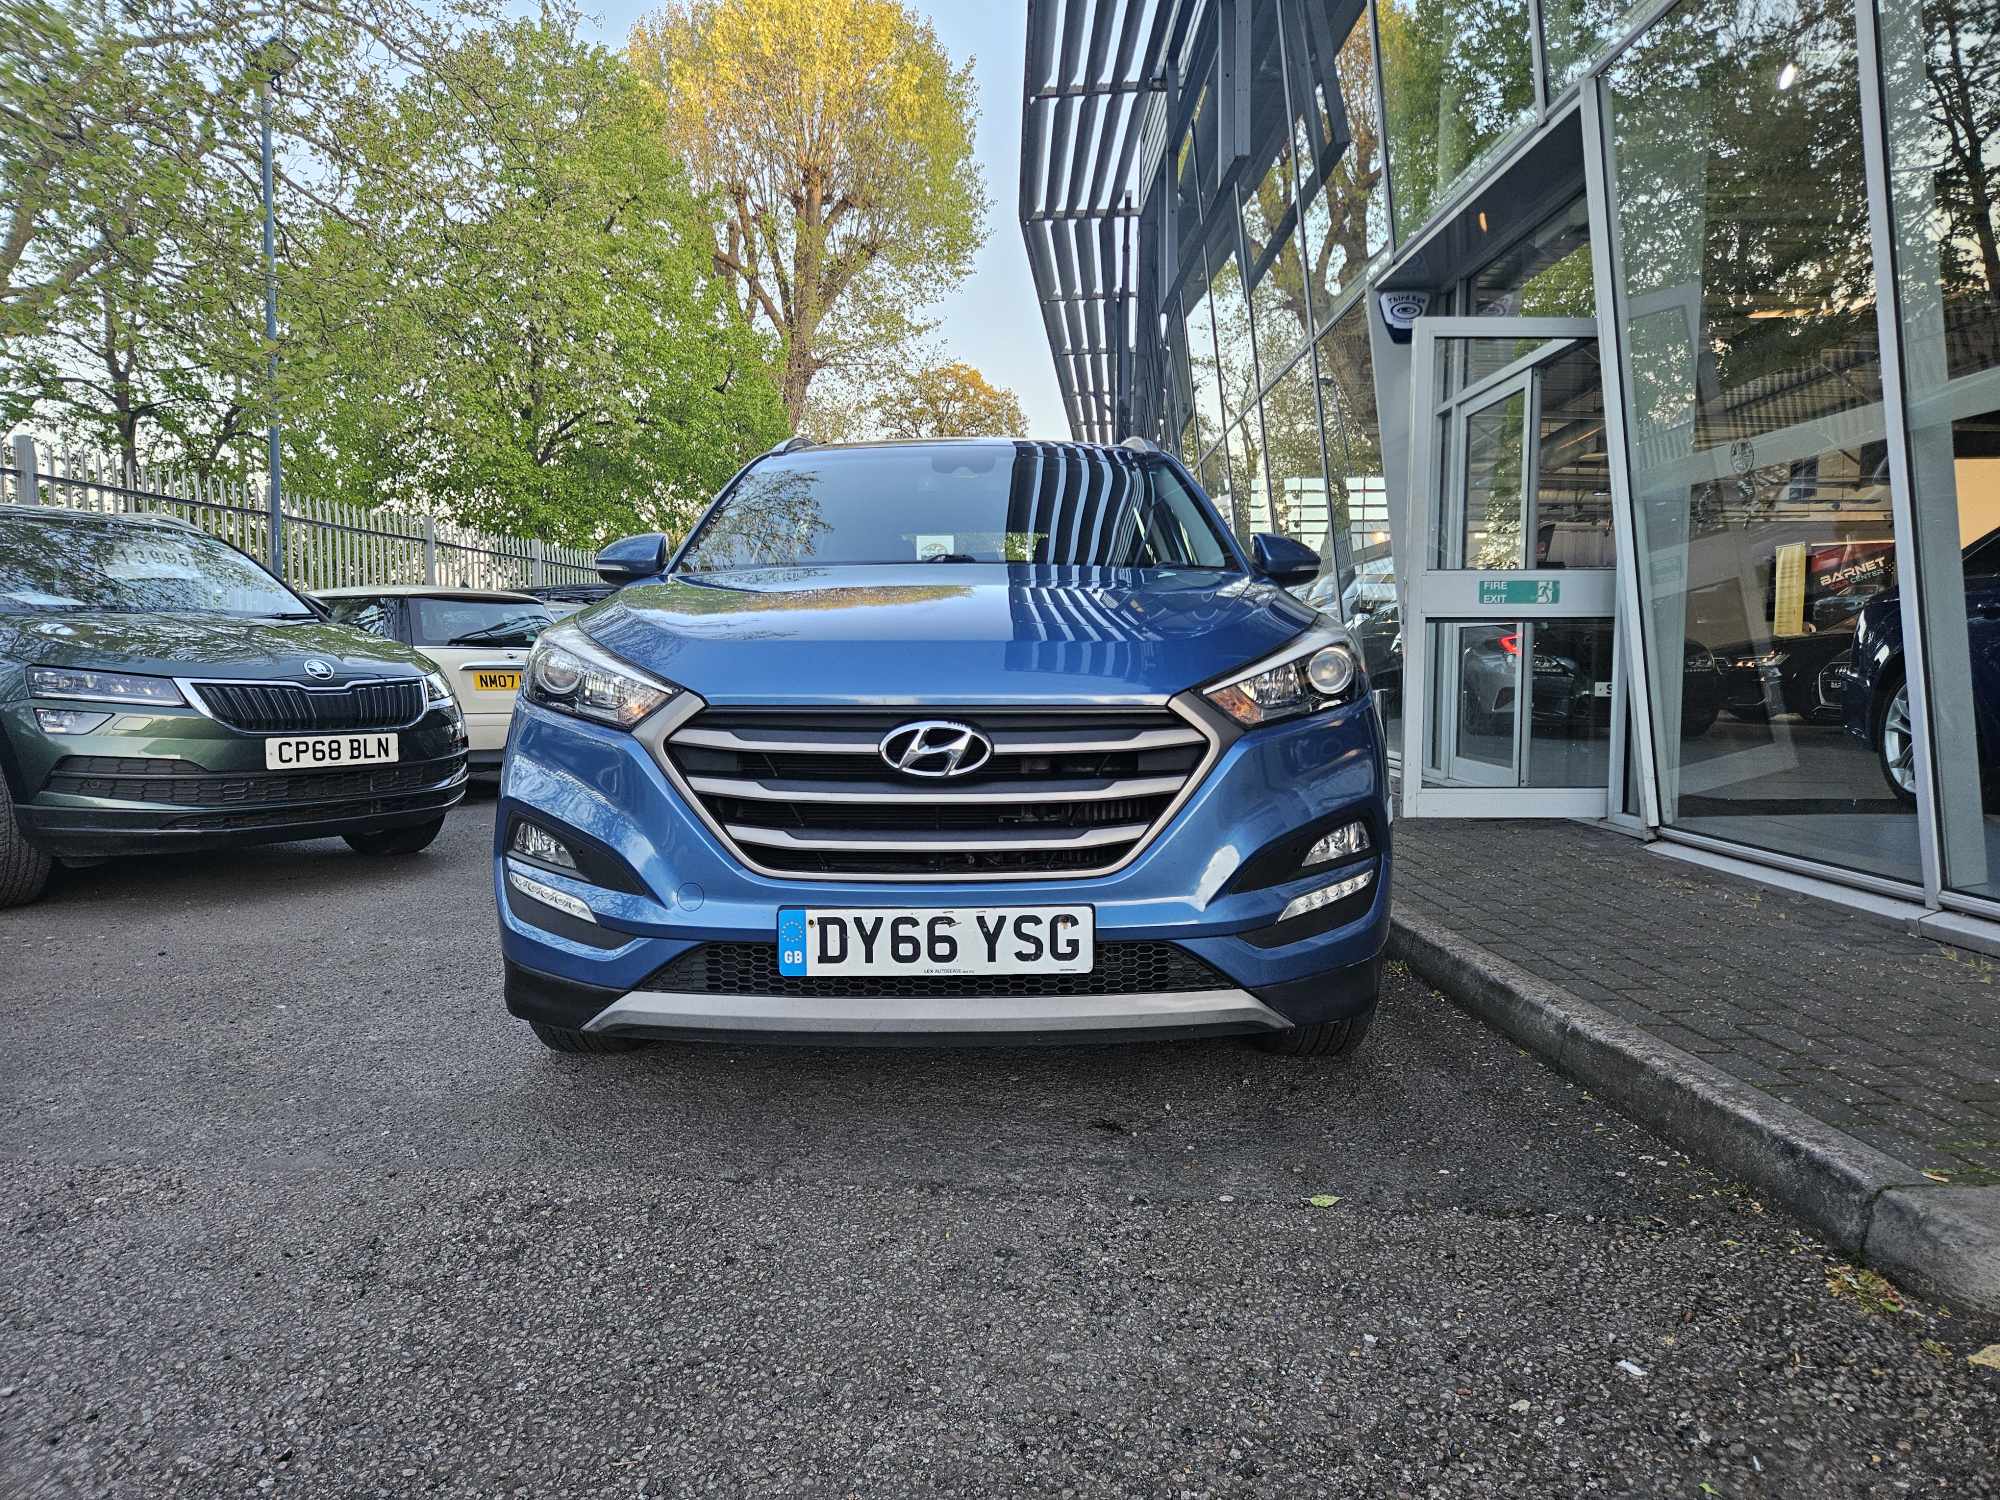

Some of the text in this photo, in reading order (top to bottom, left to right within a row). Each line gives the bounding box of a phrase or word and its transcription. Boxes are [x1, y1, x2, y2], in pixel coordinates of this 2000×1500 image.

[1820, 556, 1886, 586] BARNET
[1483, 581, 1508, 590] FIRE
[1483, 594, 1507, 604] EXIT
[480, 674, 515, 688] NM07
[278, 737, 390, 764] CP68 BLN
[817, 914, 1080, 964] DY66 YSG
[784, 950, 803, 964] GB
